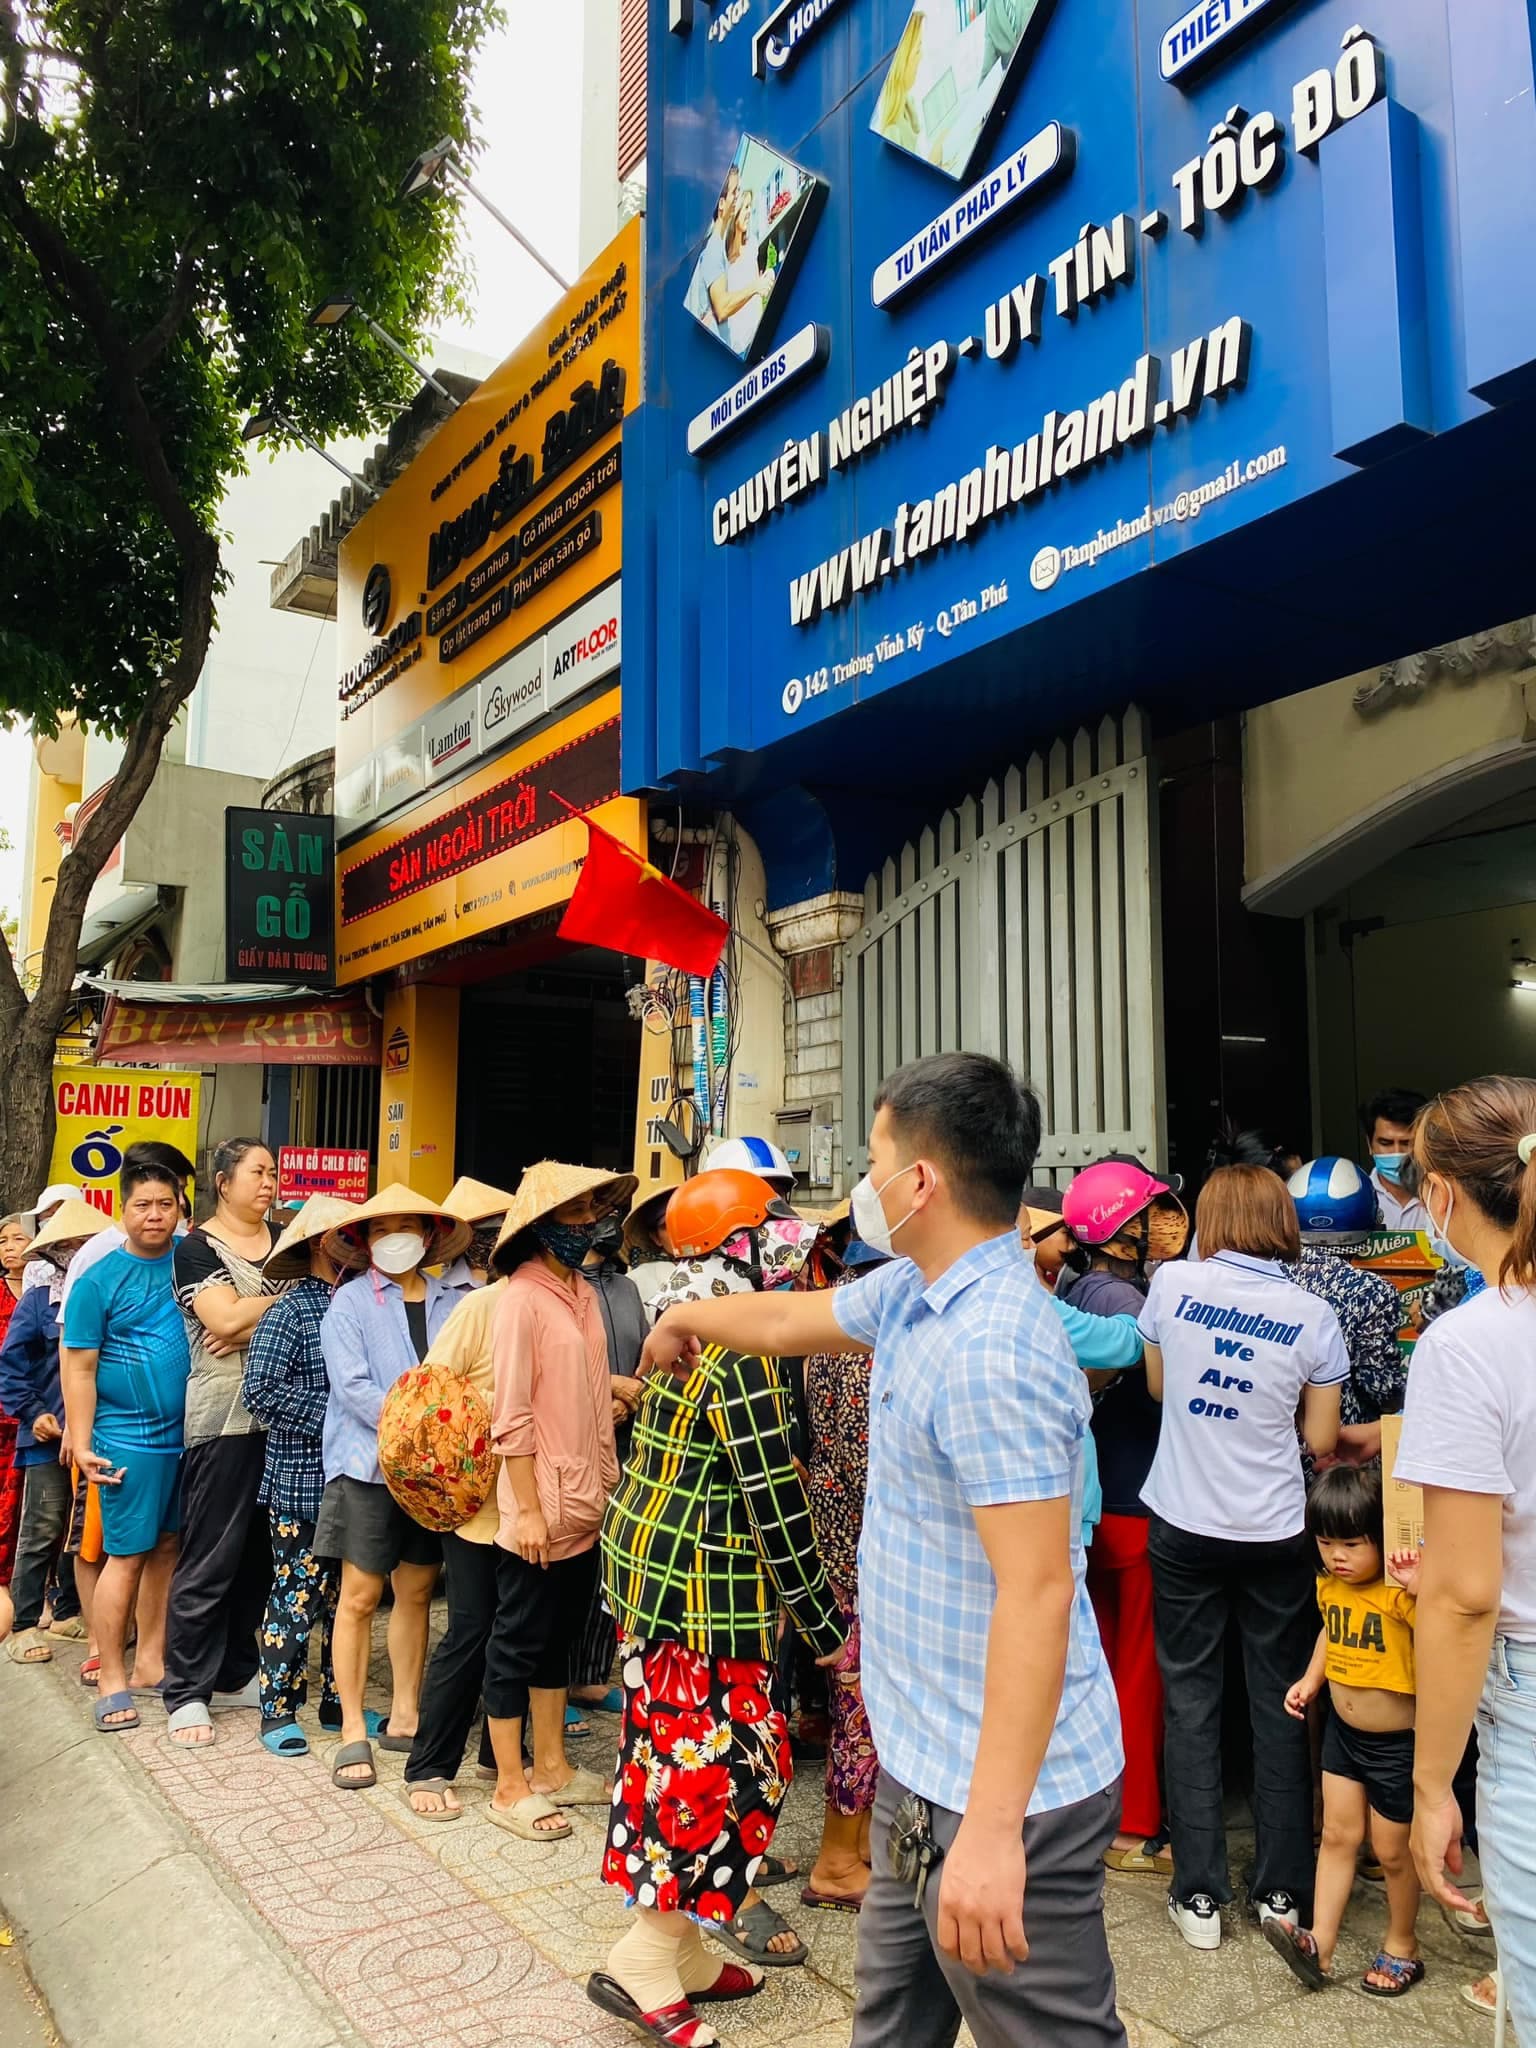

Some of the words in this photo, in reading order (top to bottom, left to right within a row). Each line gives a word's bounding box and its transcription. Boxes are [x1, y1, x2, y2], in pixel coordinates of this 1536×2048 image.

[895, 244, 915, 281] TƯ
[918, 219, 950, 263] VẤN
[955, 179, 1001, 234] PHÁP
[1007, 151, 1028, 193] LÝ
[713, 431, 820, 546] CHUYÊN
[829, 340, 948, 469] NGHIỆP
[985, 273, 1038, 359] UY
[1049, 213, 1126, 316] TÍN
[1172, 104, 1276, 231] TỐC
[711, 397, 731, 430] MÔI
[762, 353, 786, 390] BĐS
[565, 473, 595, 512] ngoài
[597, 453, 617, 483] trời
[789, 315, 1242, 626] www.tanphuland.vn
[1061, 445, 1287, 572] Tanphuland.vn@gmail.com
[534, 555, 555, 582] kiện
[553, 617, 617, 680] ARTFLOOR
[804, 668, 828, 699] 142
[875, 633, 904, 664] Vĩnh
[907, 620, 924, 651] Ký
[981, 578, 1008, 612] Phú
[494, 667, 542, 719] Skywood
[242, 823, 323, 875] SÀN
[389, 847, 421, 892] SÀN
[426, 811, 484, 875] NGOÀI
[487, 782, 536, 843] TRỜI
[256, 882, 310, 939] GỖ
[57, 1082, 131, 1117] CANH
[138, 1080, 191, 1118] BÚN
[651, 1077, 669, 1103] UY
[283, 1150, 303, 1169] SÀN
[306, 1149, 318, 1170] GỖ
[322, 1155, 344, 1171] CHLB
[347, 1151, 367, 1172] ĐỨC
[337, 1177, 366, 1189] gold
[1174, 1294, 1304, 1347] Tanphuland
[1214, 1336, 1254, 1361] We
[1198, 1368, 1253, 1393] Are
[1188, 1398, 1239, 1420] One
[1322, 1602, 1386, 1653] OLA
